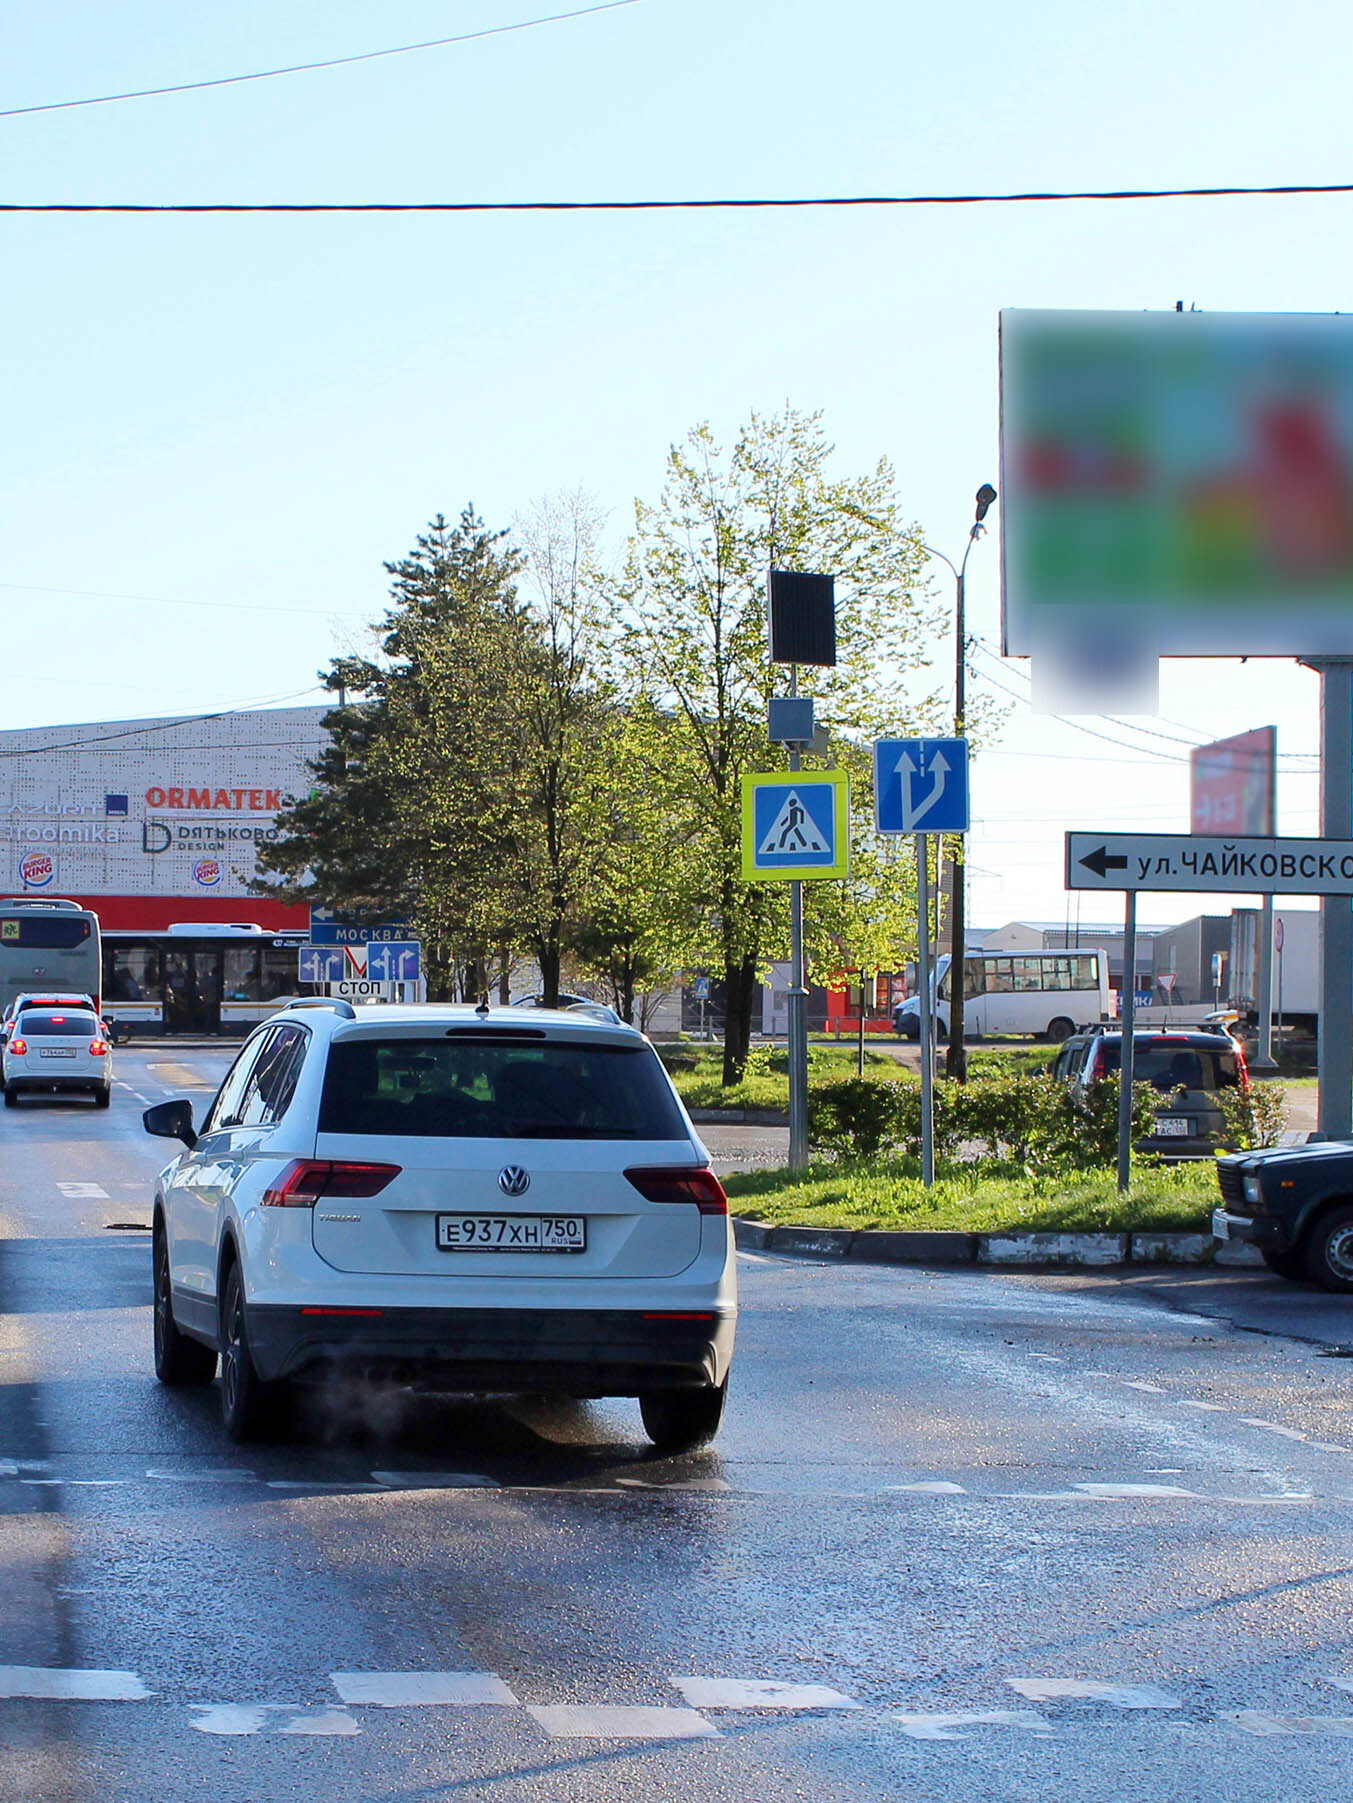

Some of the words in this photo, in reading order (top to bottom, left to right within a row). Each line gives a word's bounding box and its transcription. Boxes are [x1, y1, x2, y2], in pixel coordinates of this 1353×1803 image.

[145, 786, 281, 811] ORMATEK
[17, 824, 121, 843] roomika
[177, 841, 225, 851] DESIGN
[22, 857, 52, 871] BURGER
[23, 864, 53, 880] KING
[336, 929, 401, 941] МОСКВА
[339, 982, 381, 995] СТОП
[551, 1237, 569, 1245] RUS
